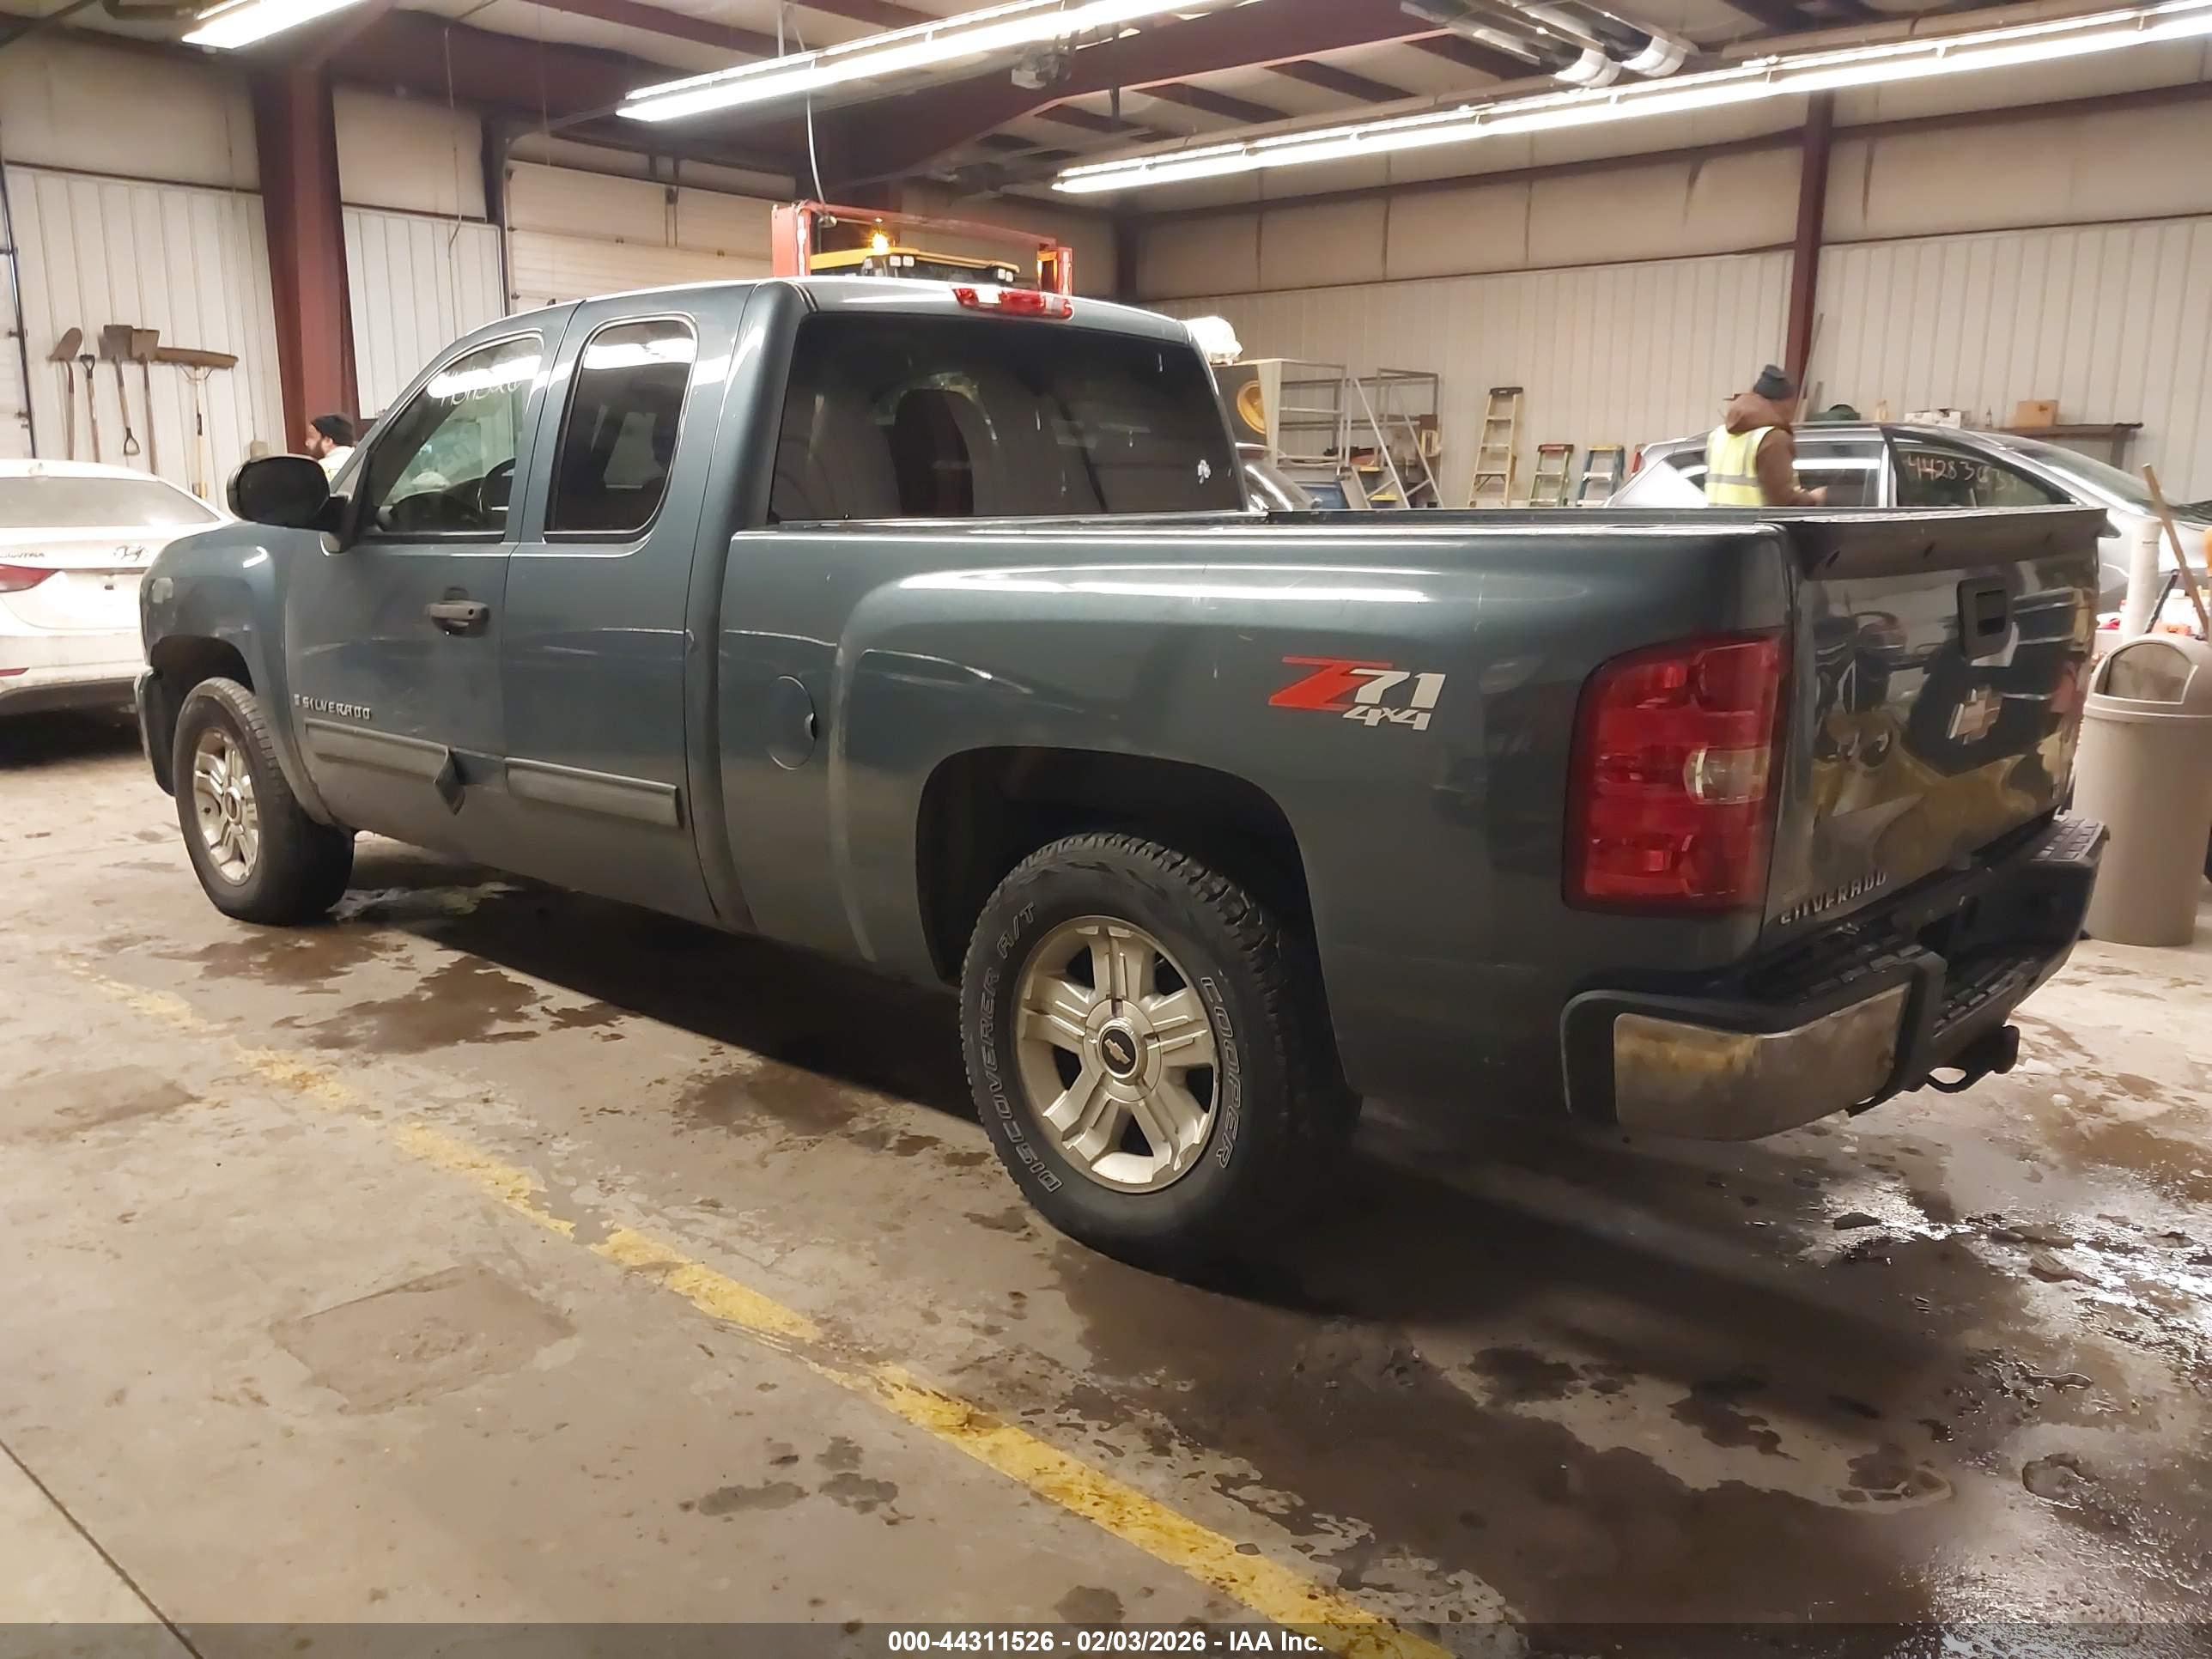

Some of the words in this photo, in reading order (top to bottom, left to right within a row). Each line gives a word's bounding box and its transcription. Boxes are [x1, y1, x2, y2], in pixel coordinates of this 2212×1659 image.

[302, 696, 371, 720] SILVERADO
[1268, 656, 1447, 712] Z71
[996, 902, 1036, 960] A/T
[980, 968, 1063, 1194] DISCOVERER
[1200, 976, 1242, 1169] COOPER
